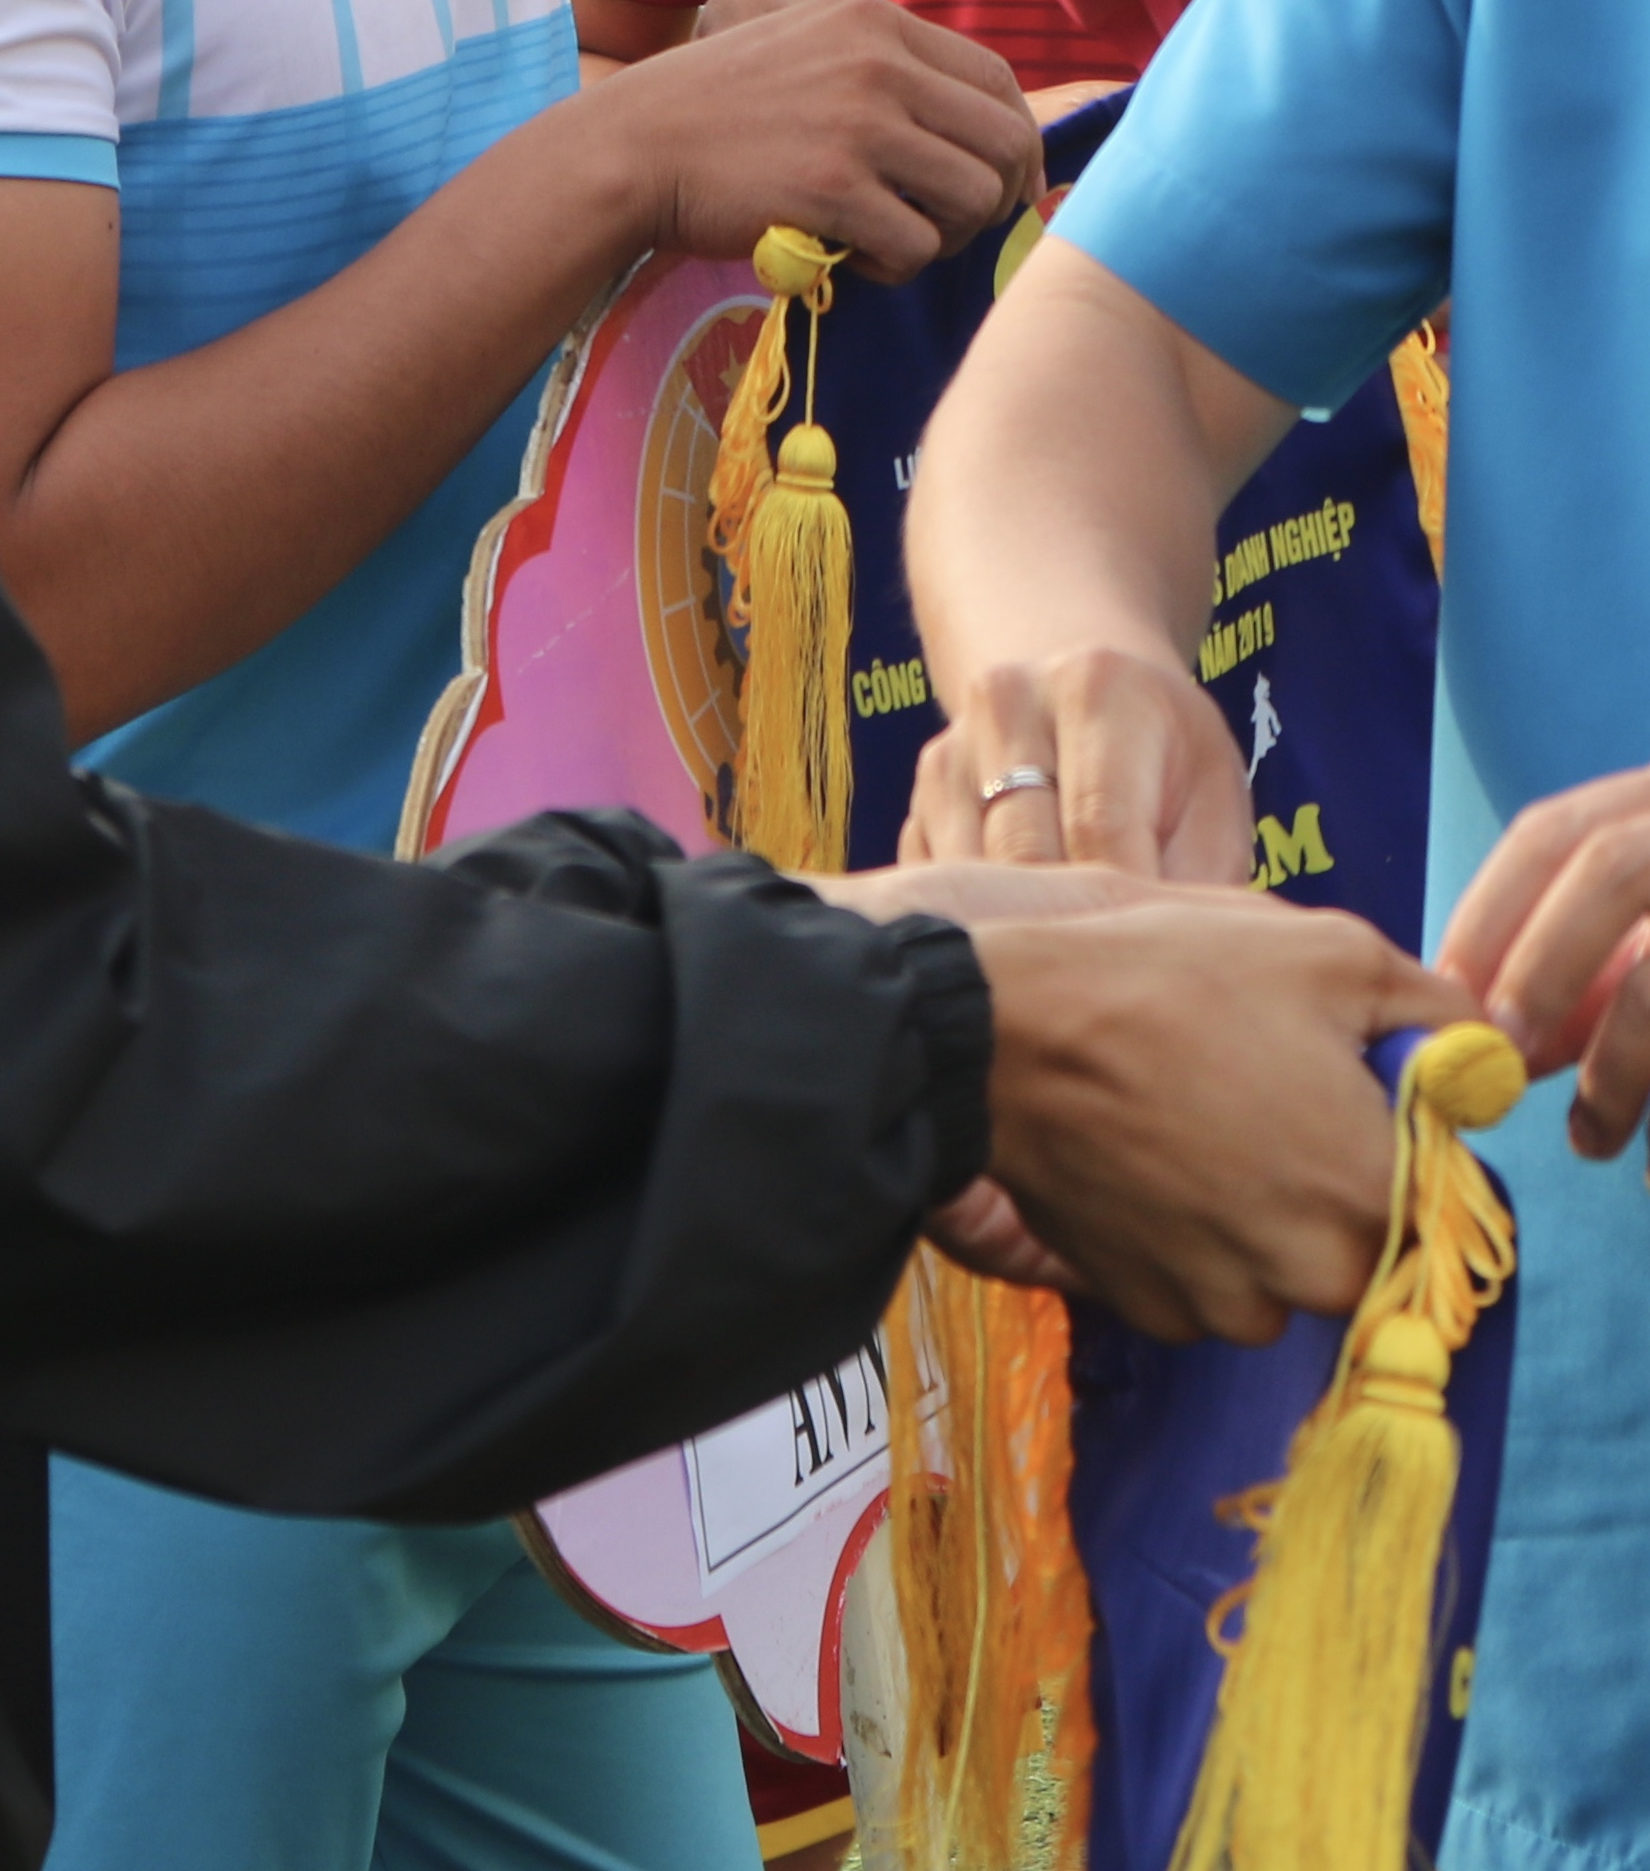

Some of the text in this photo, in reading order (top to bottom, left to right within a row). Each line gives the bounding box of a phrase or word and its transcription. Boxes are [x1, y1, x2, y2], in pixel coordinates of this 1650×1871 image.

[1270, 496, 1355, 570] NGHIỆP
[1199, 601, 1275, 684] NĂM 2019
[851, 658, 927, 718] CÔNG
